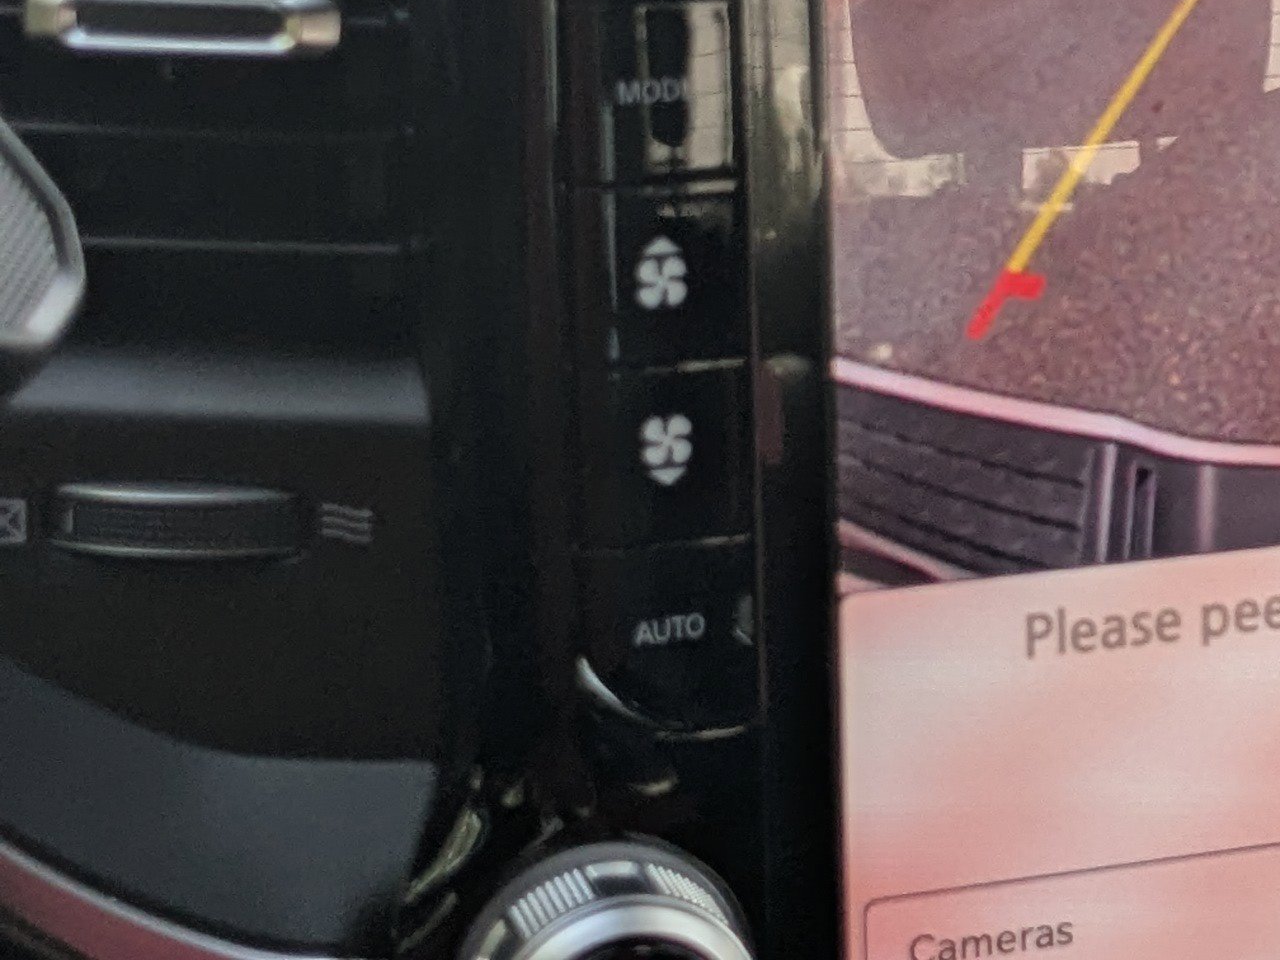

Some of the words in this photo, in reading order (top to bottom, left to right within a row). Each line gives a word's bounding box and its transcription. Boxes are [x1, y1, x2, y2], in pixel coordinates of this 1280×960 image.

[615, 77, 694, 107] MOD
[633, 612, 706, 646] AUTO
[1025, 605, 1182, 660] Please
[910, 921, 1074, 960] Cameras
